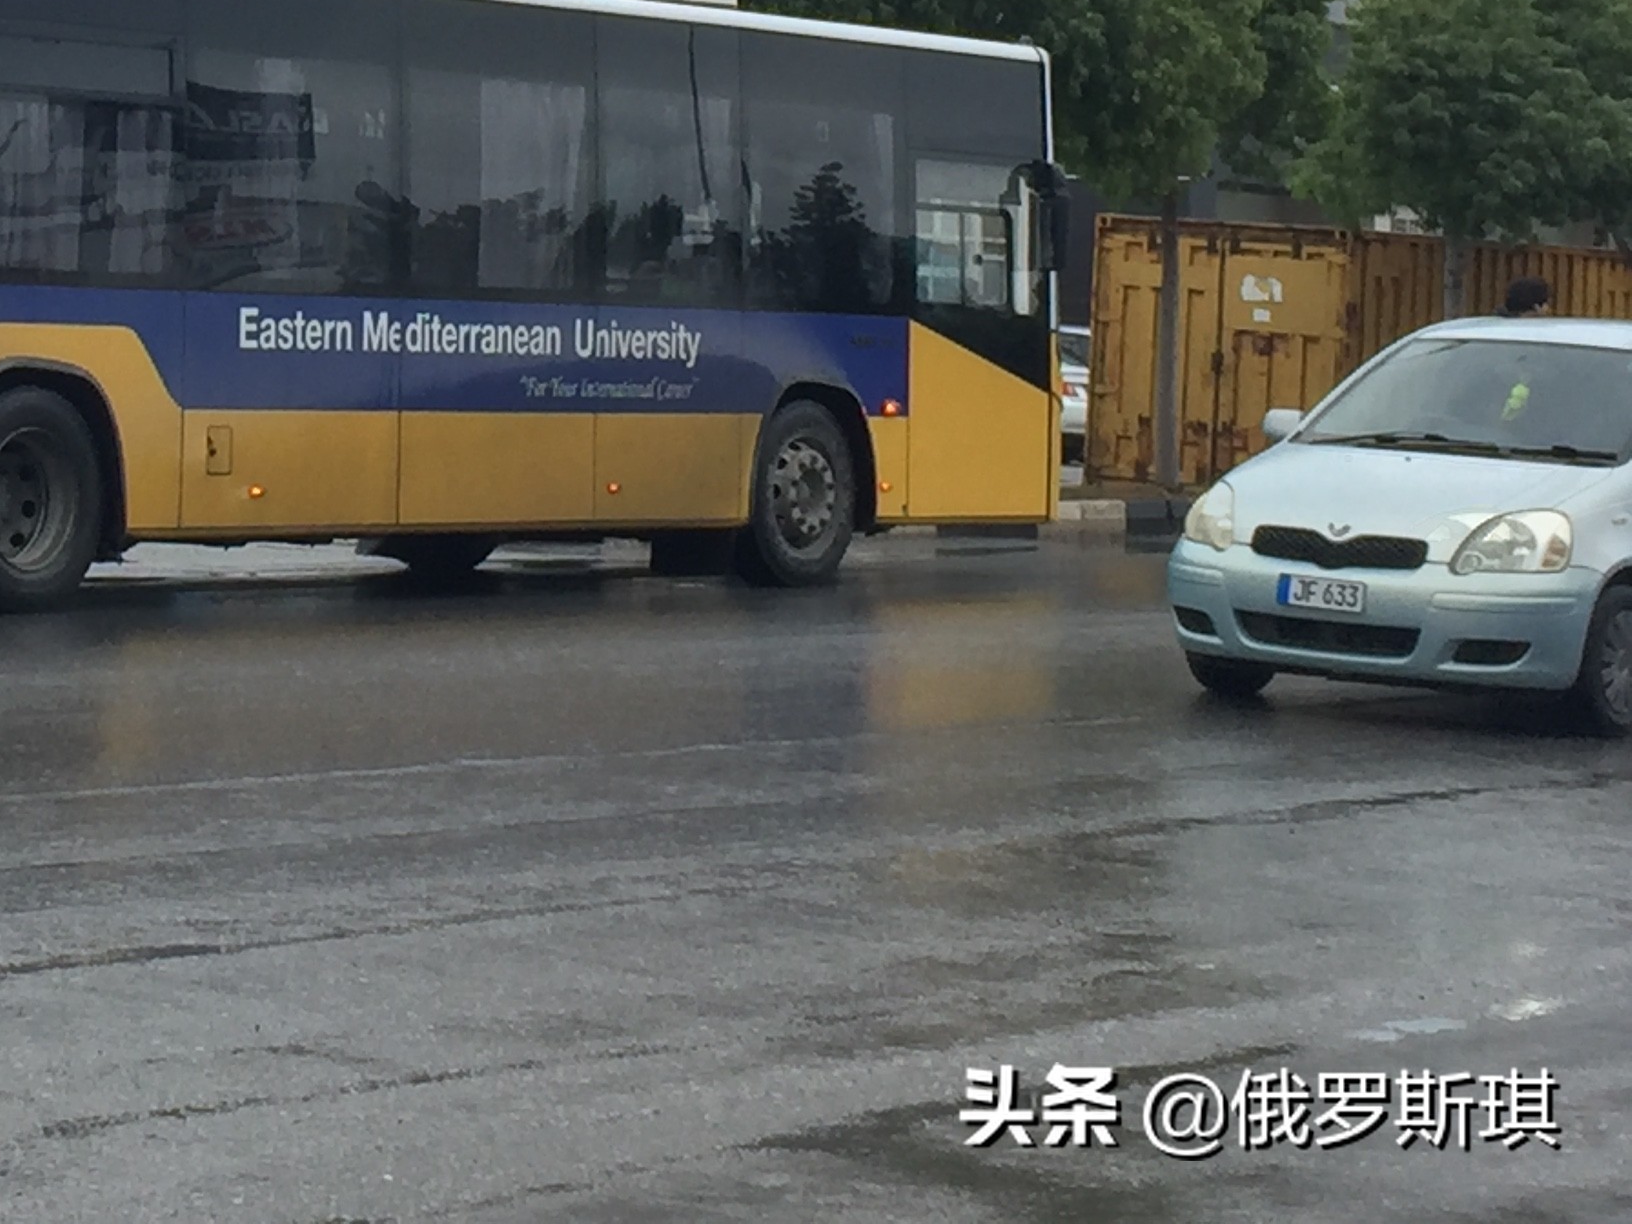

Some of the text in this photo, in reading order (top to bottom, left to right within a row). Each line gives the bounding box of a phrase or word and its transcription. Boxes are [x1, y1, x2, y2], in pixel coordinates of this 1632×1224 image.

[239, 306, 702, 368] Eastern Mediterranean University
[1293, 578, 1360, 608] JF 633
